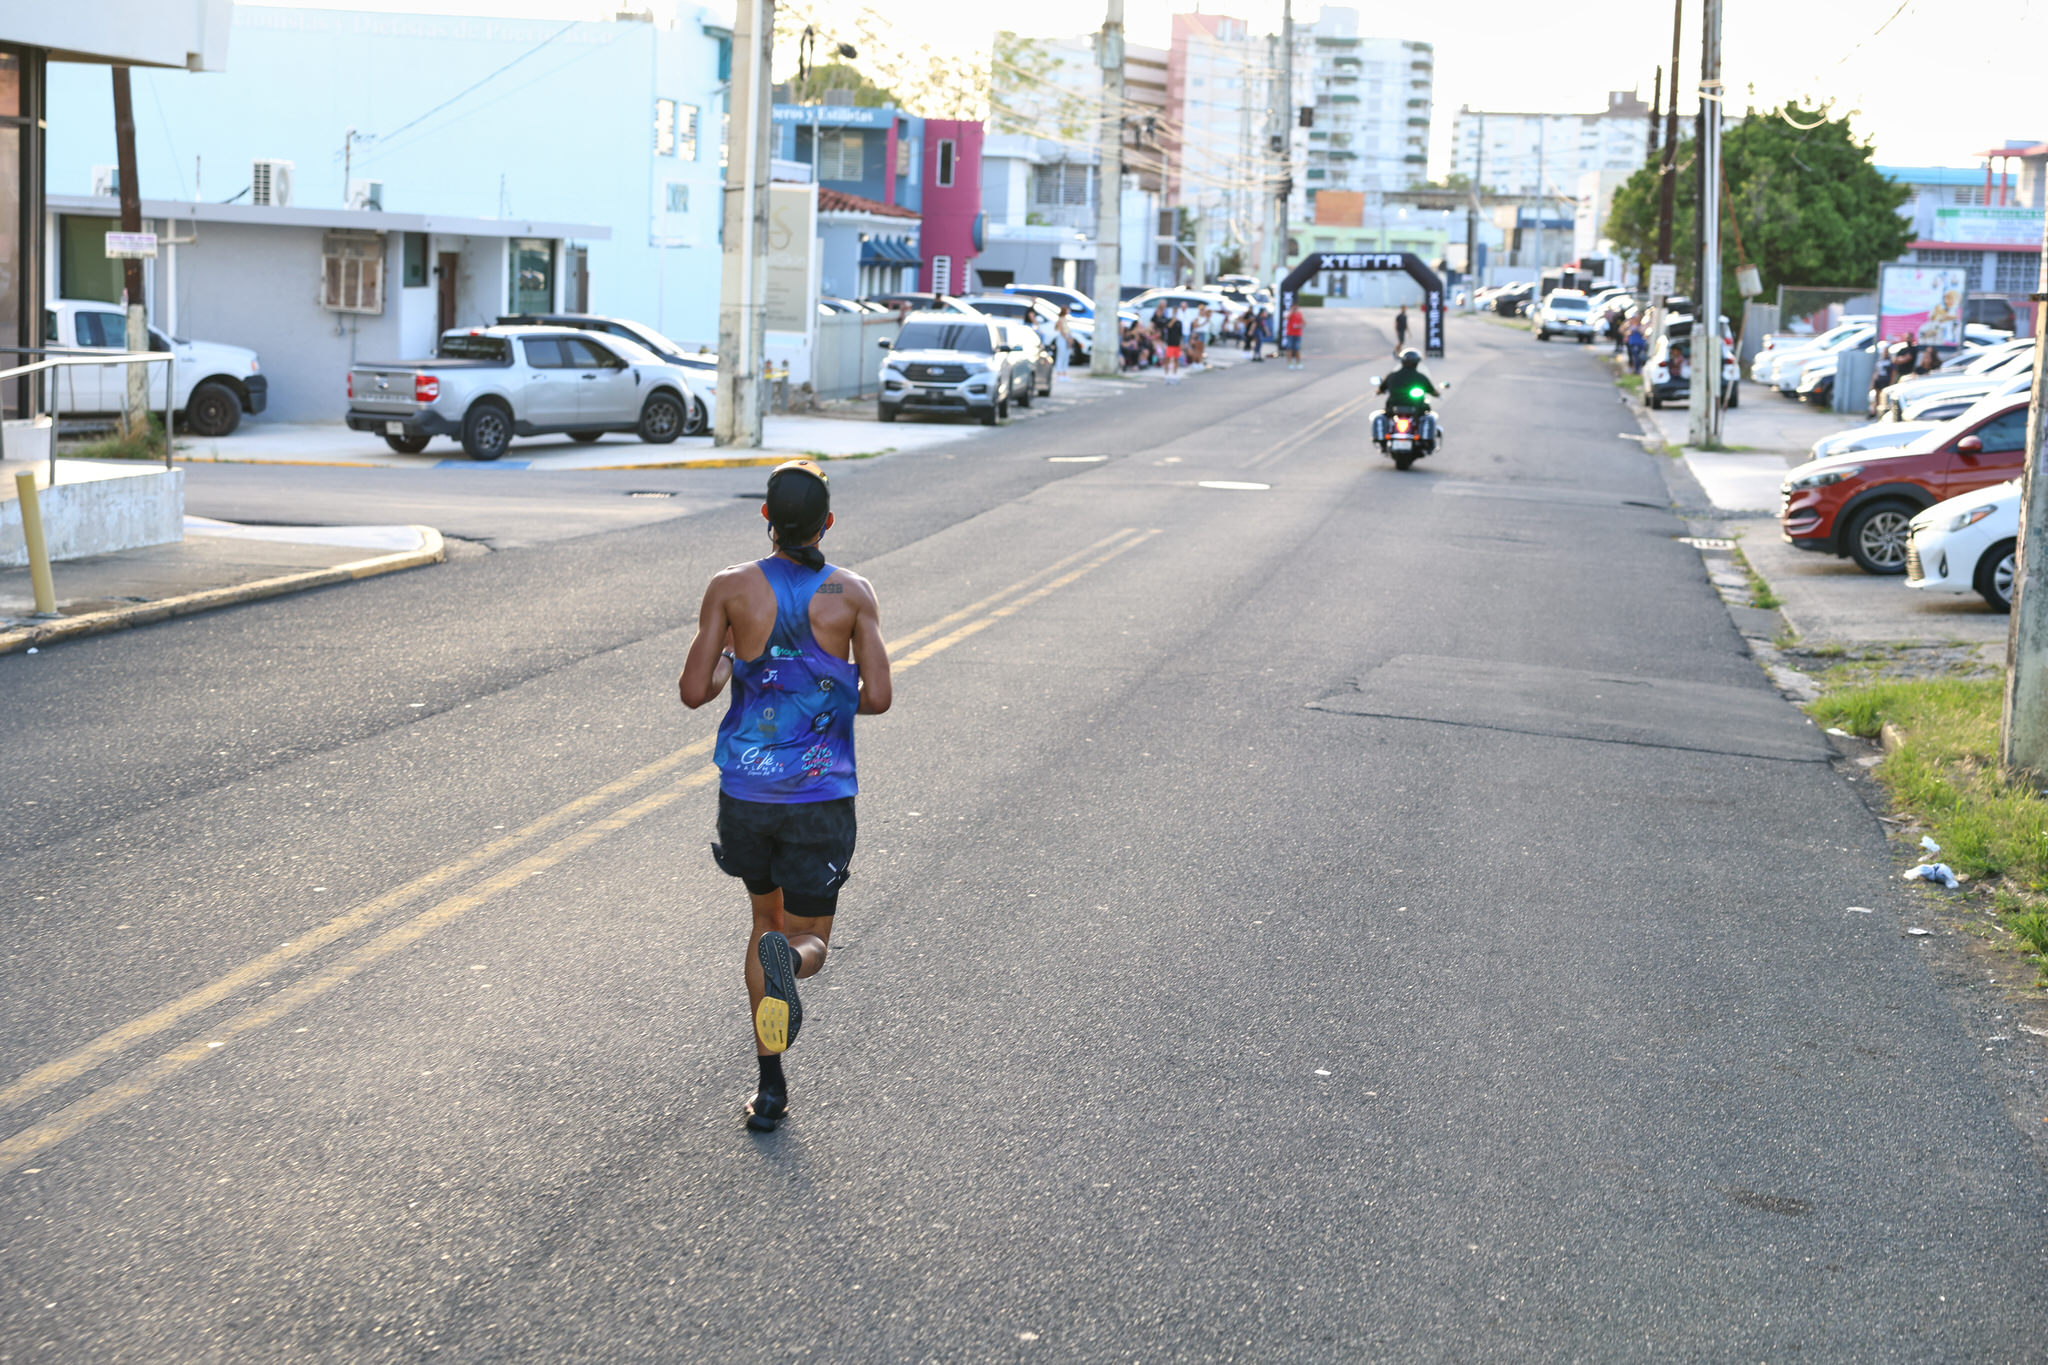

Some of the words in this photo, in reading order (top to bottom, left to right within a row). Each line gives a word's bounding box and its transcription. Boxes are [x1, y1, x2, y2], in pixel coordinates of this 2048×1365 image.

[353, 15, 447, 38] Dietistas
[454, 20, 479, 39] de
[486, 22, 555, 43] Puerto
[1320, 254, 1403, 269] XTERRA
[1429, 291, 1441, 348] XTERRA
